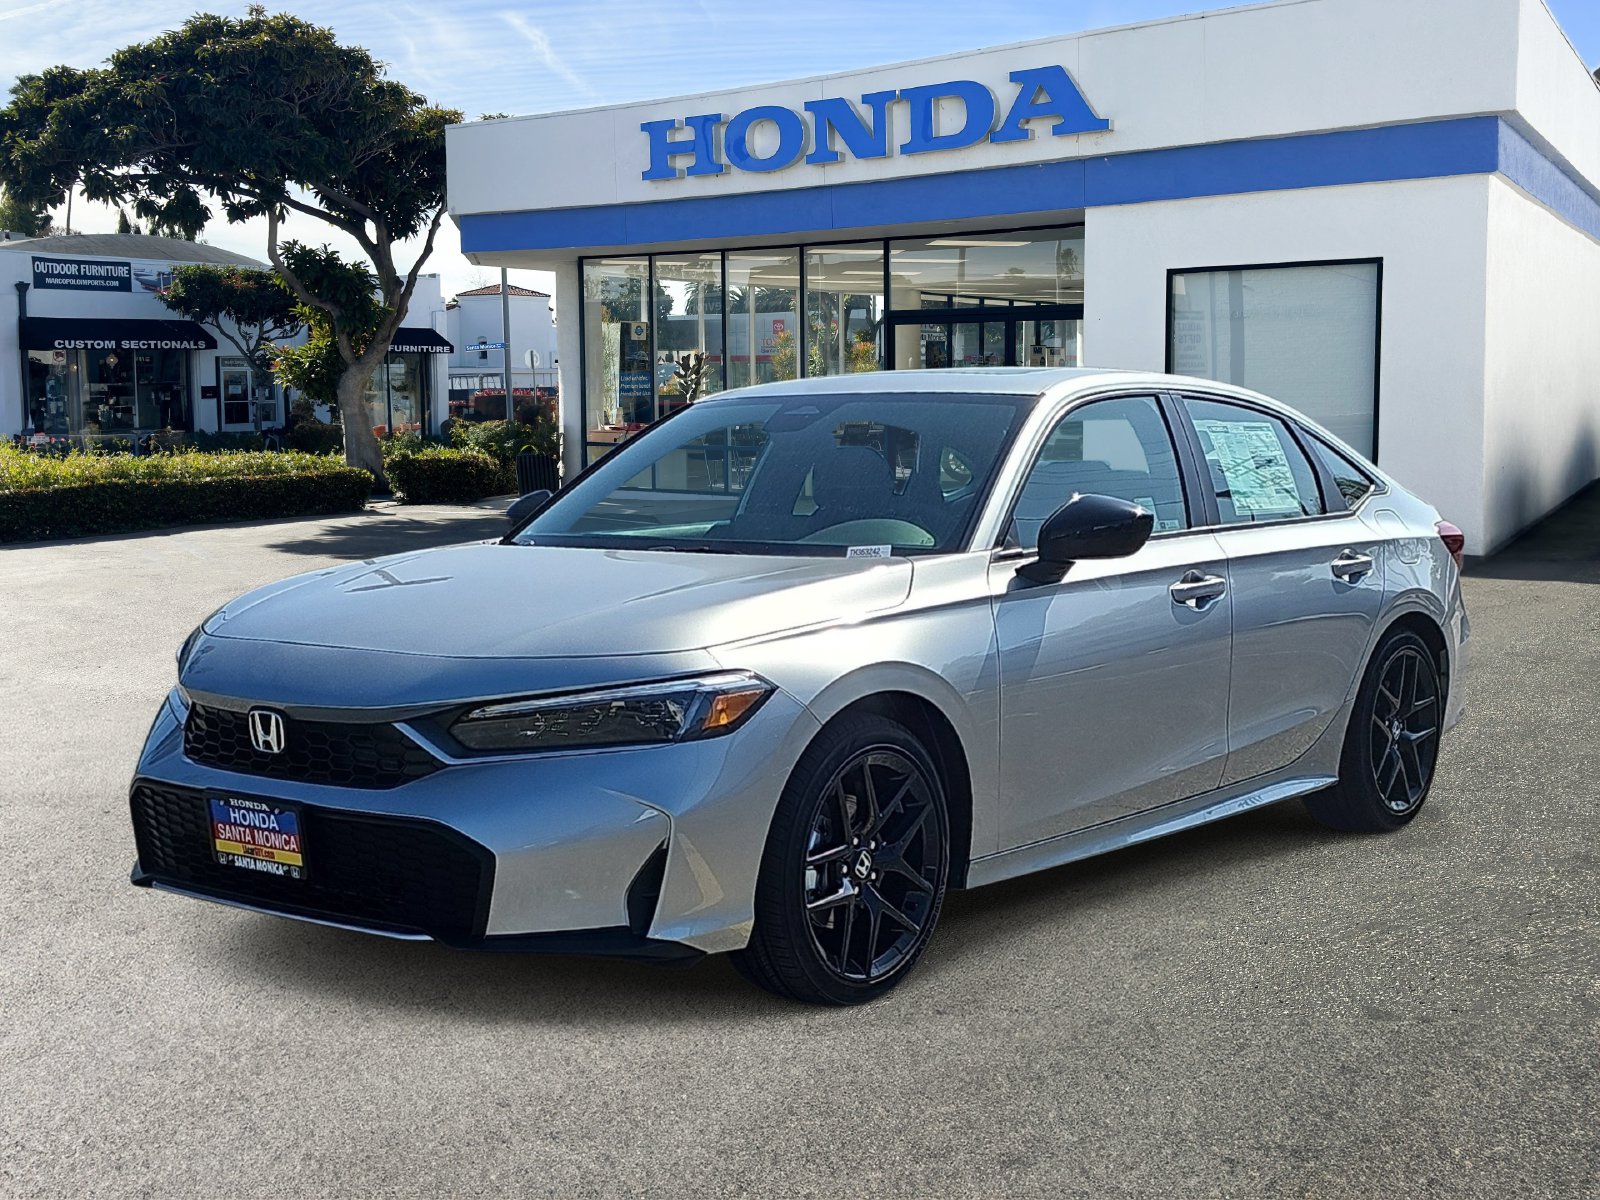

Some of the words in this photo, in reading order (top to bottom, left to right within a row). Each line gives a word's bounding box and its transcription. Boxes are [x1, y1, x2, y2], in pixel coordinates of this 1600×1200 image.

[641, 64, 1114, 181] HONDA
[34, 261, 79, 275] OUTDOOR
[80, 264, 130, 277] FURNITURE
[45, 277, 119, 287] MARCOPOLOIMPORTS.COM
[54, 339, 116, 349] CUSTOM
[121, 340, 206, 349] SECTIONALS
[388, 344, 451, 353] FURNITURE
[229, 798, 270, 812] HONDA
[229, 807, 280, 831] HONDA
[217, 823, 253, 844] SANTA
[254, 829, 299, 852] MONICA
[234, 855, 256, 870] SANTA
[256, 859, 285, 876] MONICA
